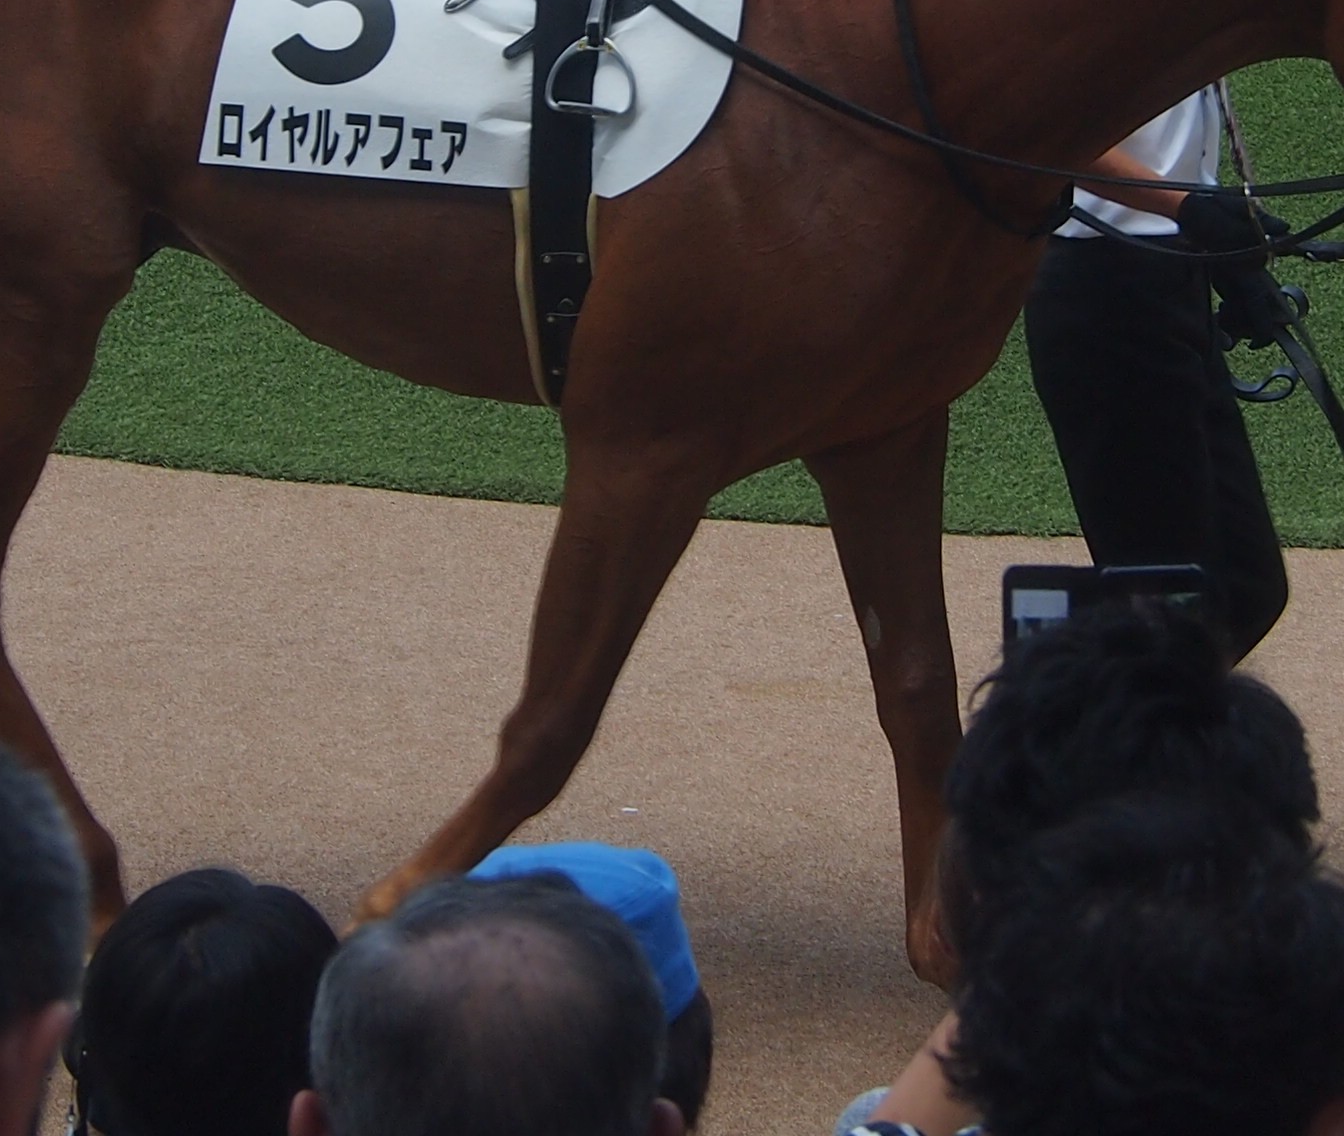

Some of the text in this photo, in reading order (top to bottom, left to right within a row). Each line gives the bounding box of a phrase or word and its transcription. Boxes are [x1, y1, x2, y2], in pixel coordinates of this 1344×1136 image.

[216, 102, 468, 174] ロイヤルアフェア
